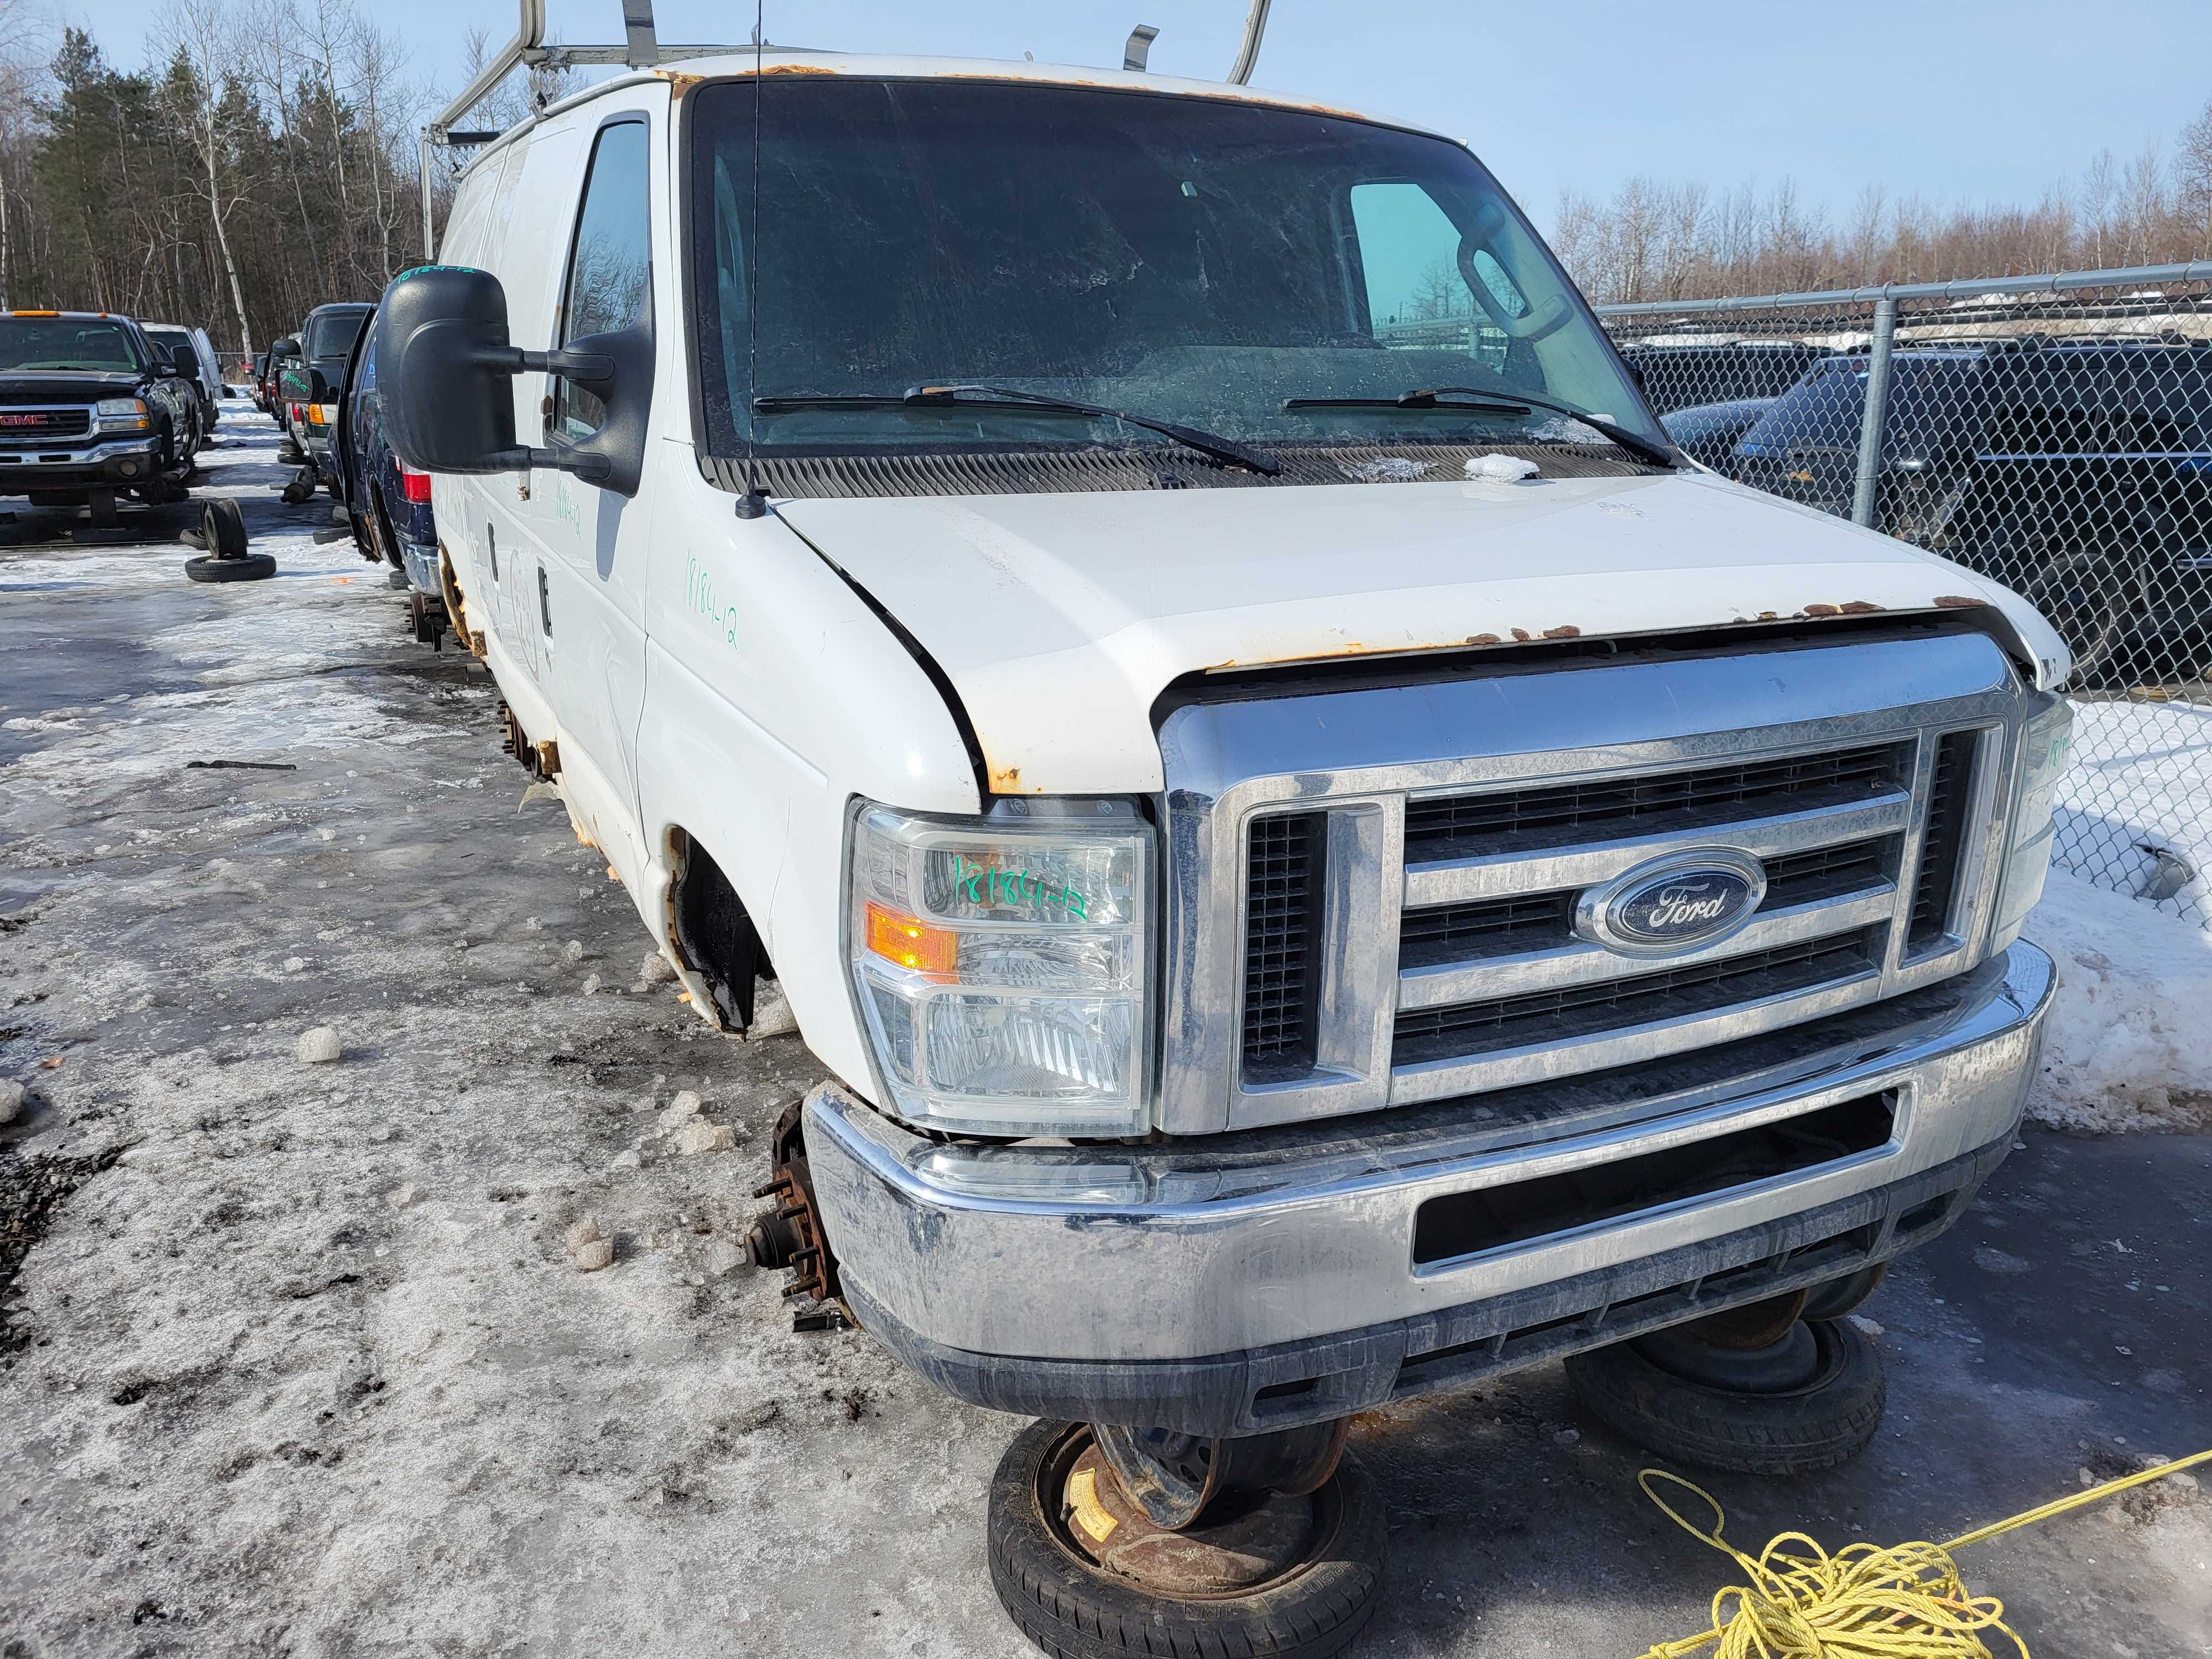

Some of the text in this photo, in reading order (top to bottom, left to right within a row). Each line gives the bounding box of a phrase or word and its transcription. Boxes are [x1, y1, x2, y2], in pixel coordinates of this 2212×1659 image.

[0, 415, 49, 425] GMC
[684, 548, 737, 650] 18184-12
[956, 855, 1087, 920] 18184-12
[1649, 883, 1728, 927] Ford
